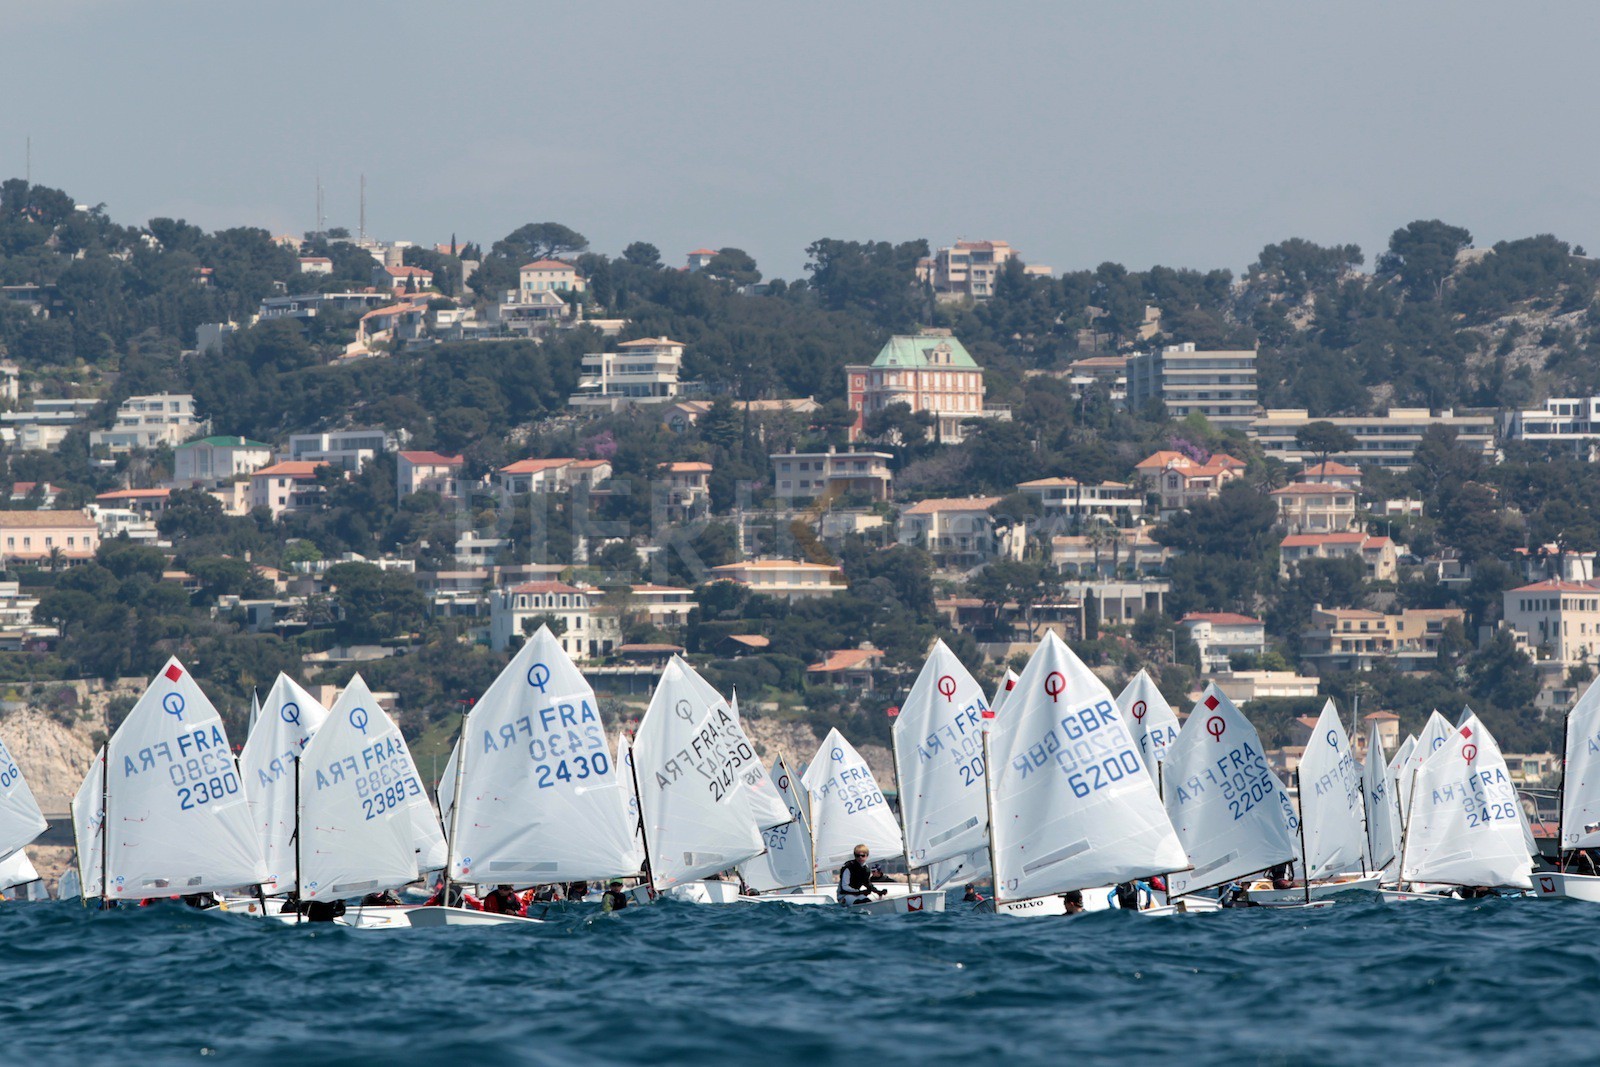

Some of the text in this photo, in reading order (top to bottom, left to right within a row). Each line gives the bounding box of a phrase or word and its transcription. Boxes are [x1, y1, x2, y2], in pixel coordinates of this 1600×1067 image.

[539, 700, 596, 732] FRA
[954, 698, 987, 735] FRA
[1061, 700, 1118, 740] GBR
[177, 725, 224, 757] FRA
[362, 737, 395, 770] FRA
[1140, 726, 1177, 754] FRA
[535, 752, 608, 789] 2430
[840, 766, 870, 784] FRA
[959, 751, 985, 786] 20
[1067, 749, 1140, 798] 6200
[1217, 742, 1256, 778] FRA
[177, 772, 238, 810] 2380
[1469, 768, 1507, 792] FRA
[845, 792, 882, 815] 2220
[1228, 773, 1273, 821] 2205
[1466, 802, 1516, 828] 2426
[1007, 900, 1044, 910] VOLVO
